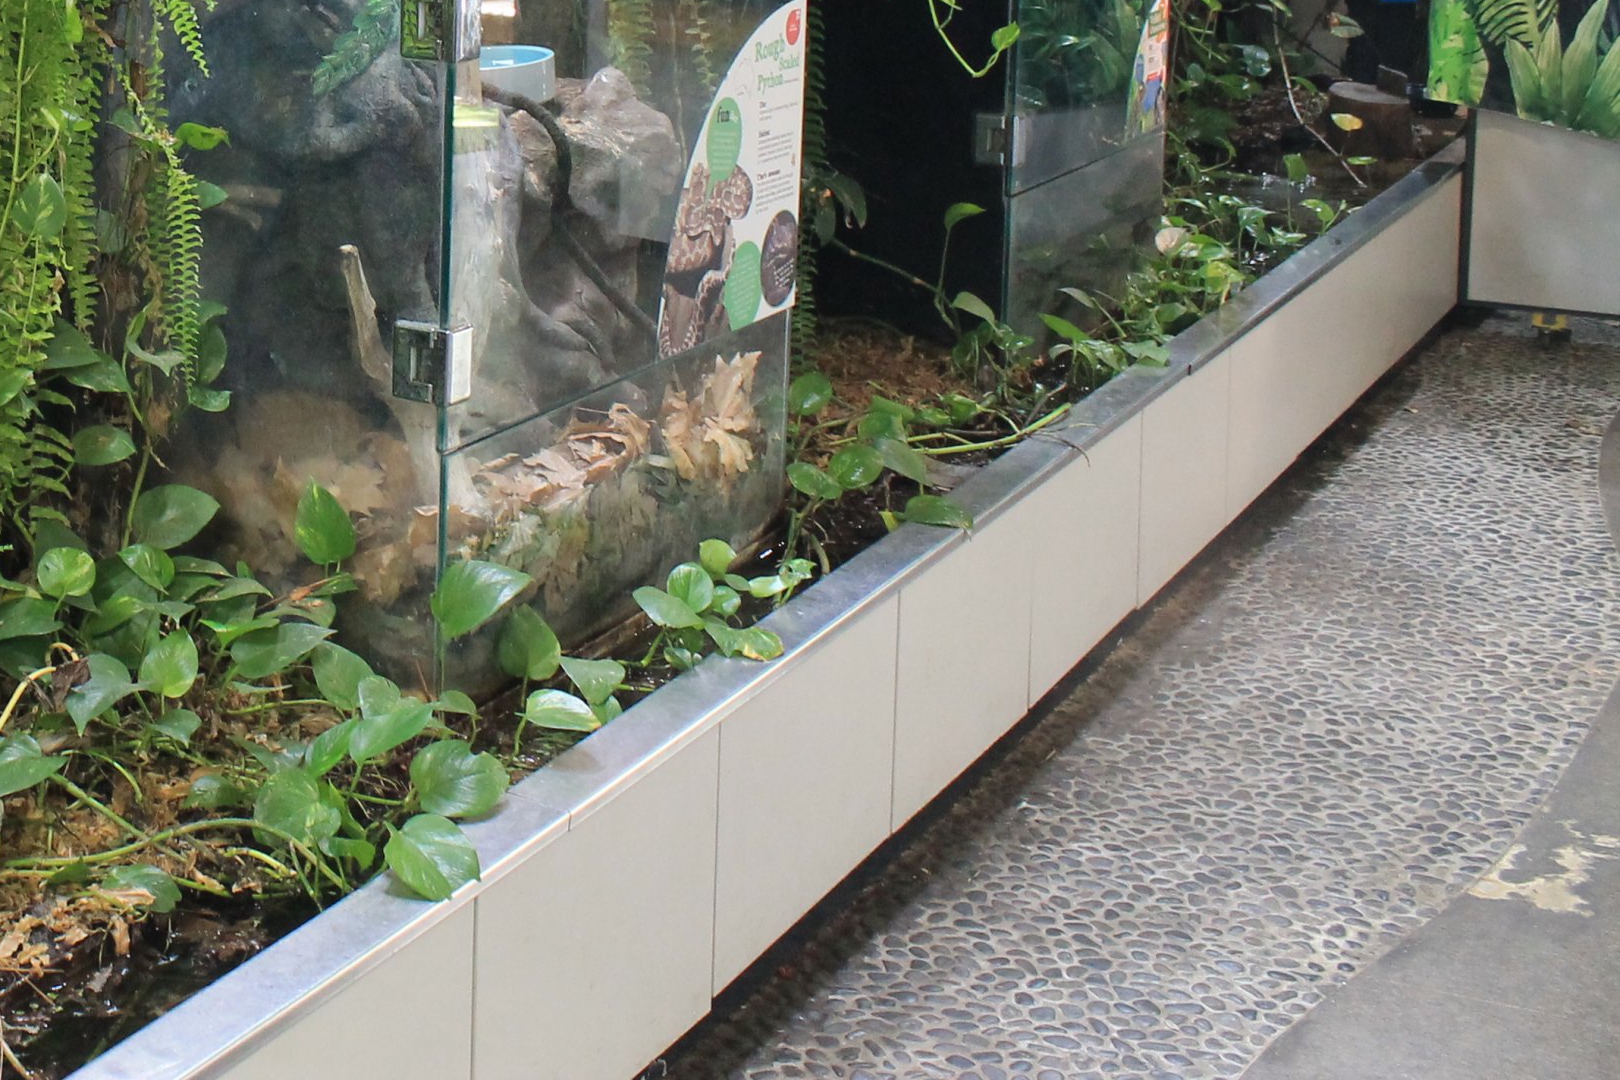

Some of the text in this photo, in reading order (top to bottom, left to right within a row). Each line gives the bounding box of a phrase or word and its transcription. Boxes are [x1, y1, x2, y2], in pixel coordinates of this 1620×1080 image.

[755, 32, 785, 62] Rough
[780, 51, 799, 70] Scaled
[758, 72, 782, 94] Python
